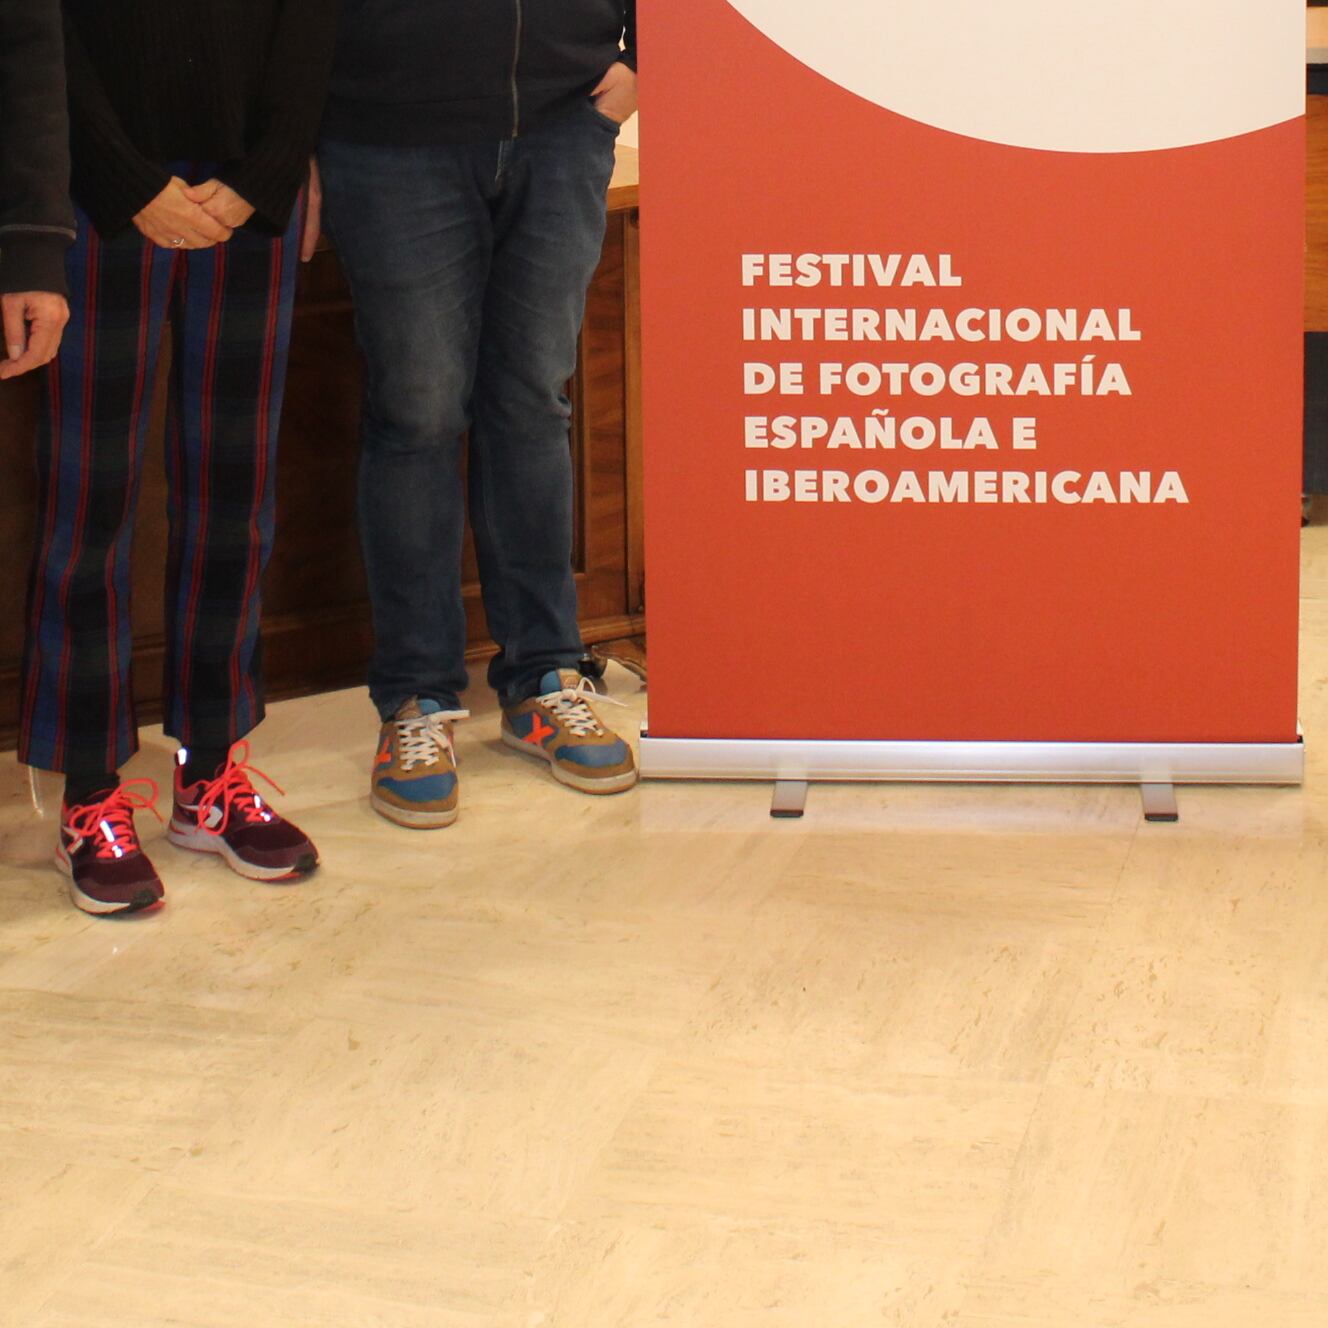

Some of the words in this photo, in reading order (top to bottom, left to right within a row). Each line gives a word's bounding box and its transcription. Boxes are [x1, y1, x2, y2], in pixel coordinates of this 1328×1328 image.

[741, 253, 962, 287] FESTIVAL
[742, 308, 1141, 342] INTERNACIONAL
[743, 363, 804, 395] DE
[819, 354, 1132, 396] FOTOGRAFÍA
[744, 408, 999, 450] ESPAÑOLA
[1012, 417, 1037, 449] E
[745, 469, 1190, 504] IBEROAMERICANA
